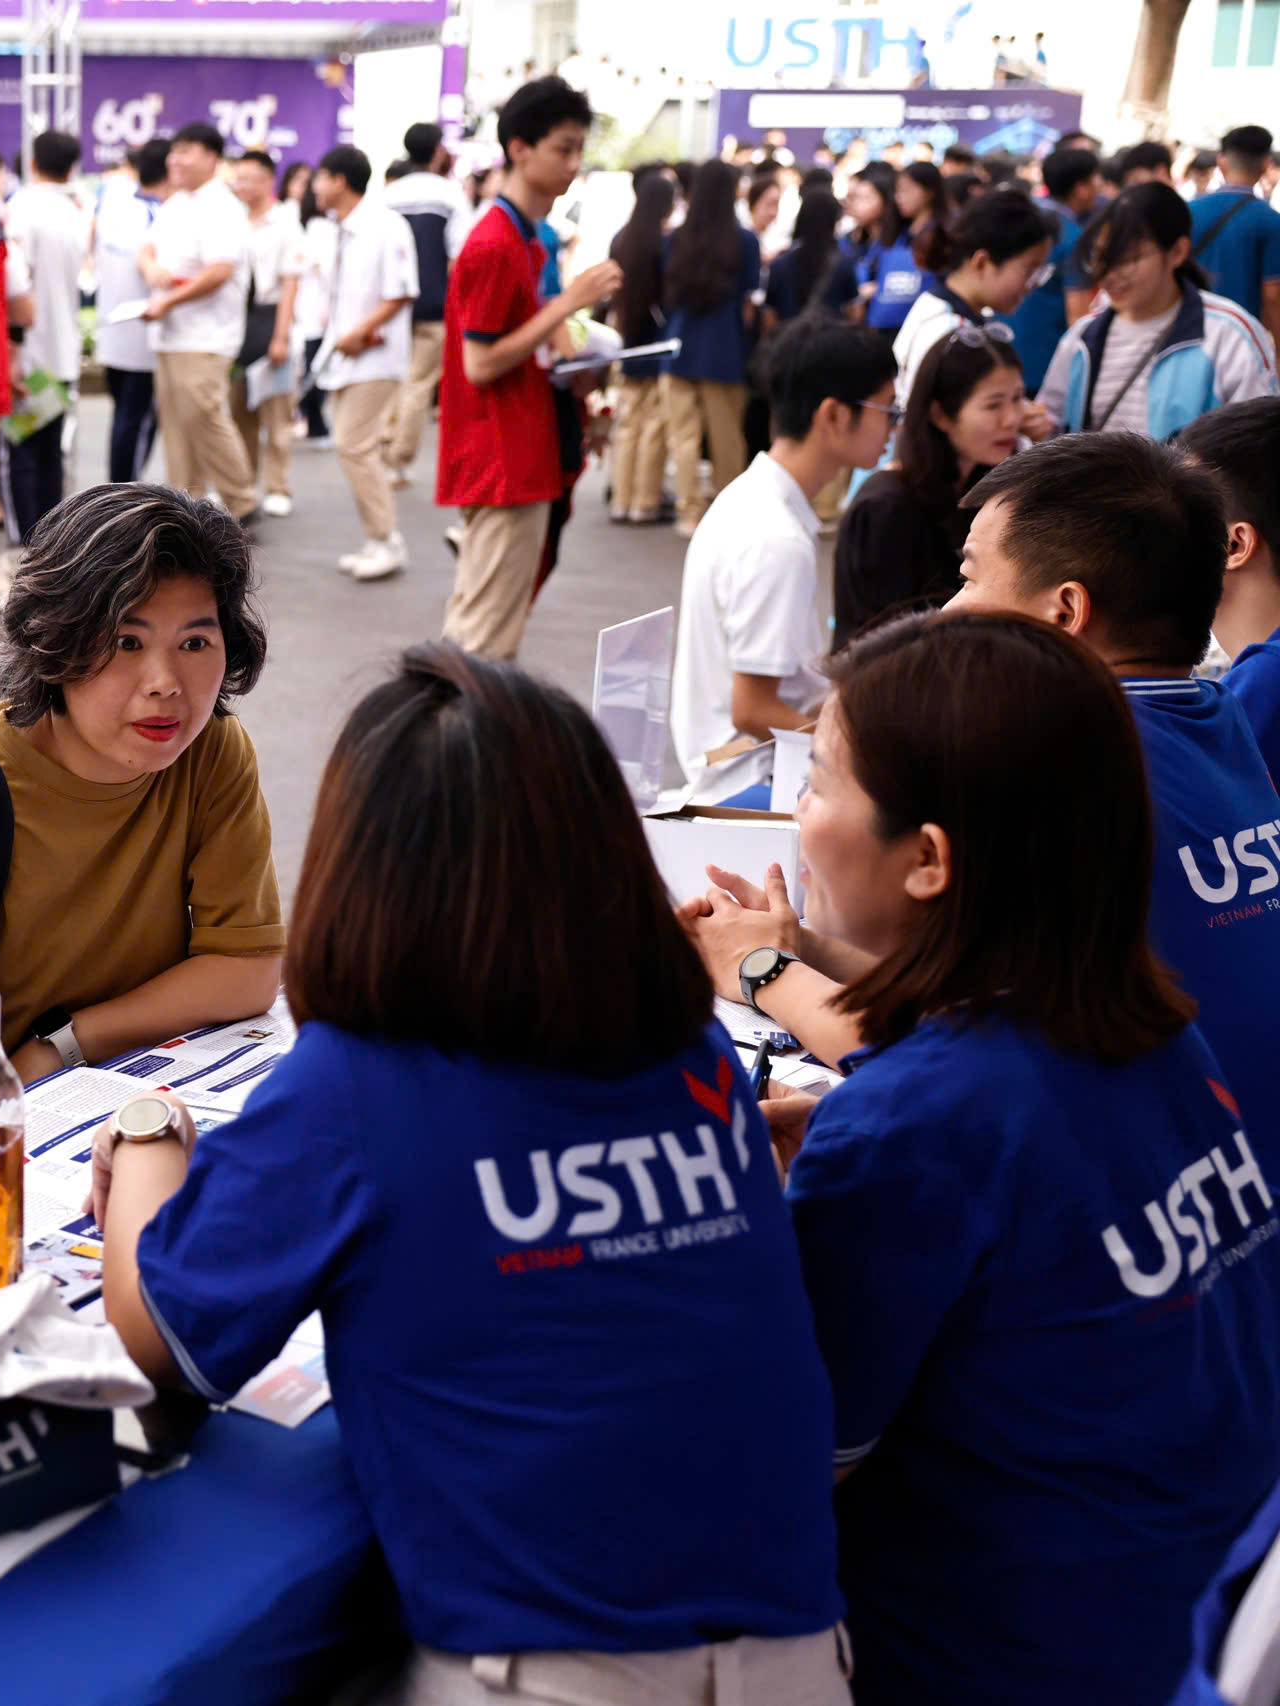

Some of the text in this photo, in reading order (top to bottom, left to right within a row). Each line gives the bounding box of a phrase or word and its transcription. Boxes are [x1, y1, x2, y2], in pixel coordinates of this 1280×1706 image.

[725, 17, 922, 69] USTH
[1177, 818, 1280, 904] UST
[1207, 903, 1264, 929] VIETNAM
[474, 1123, 737, 1243] USTH
[1101, 1129, 1274, 1297] USTH
[590, 1228, 660, 1261] FRANCE
